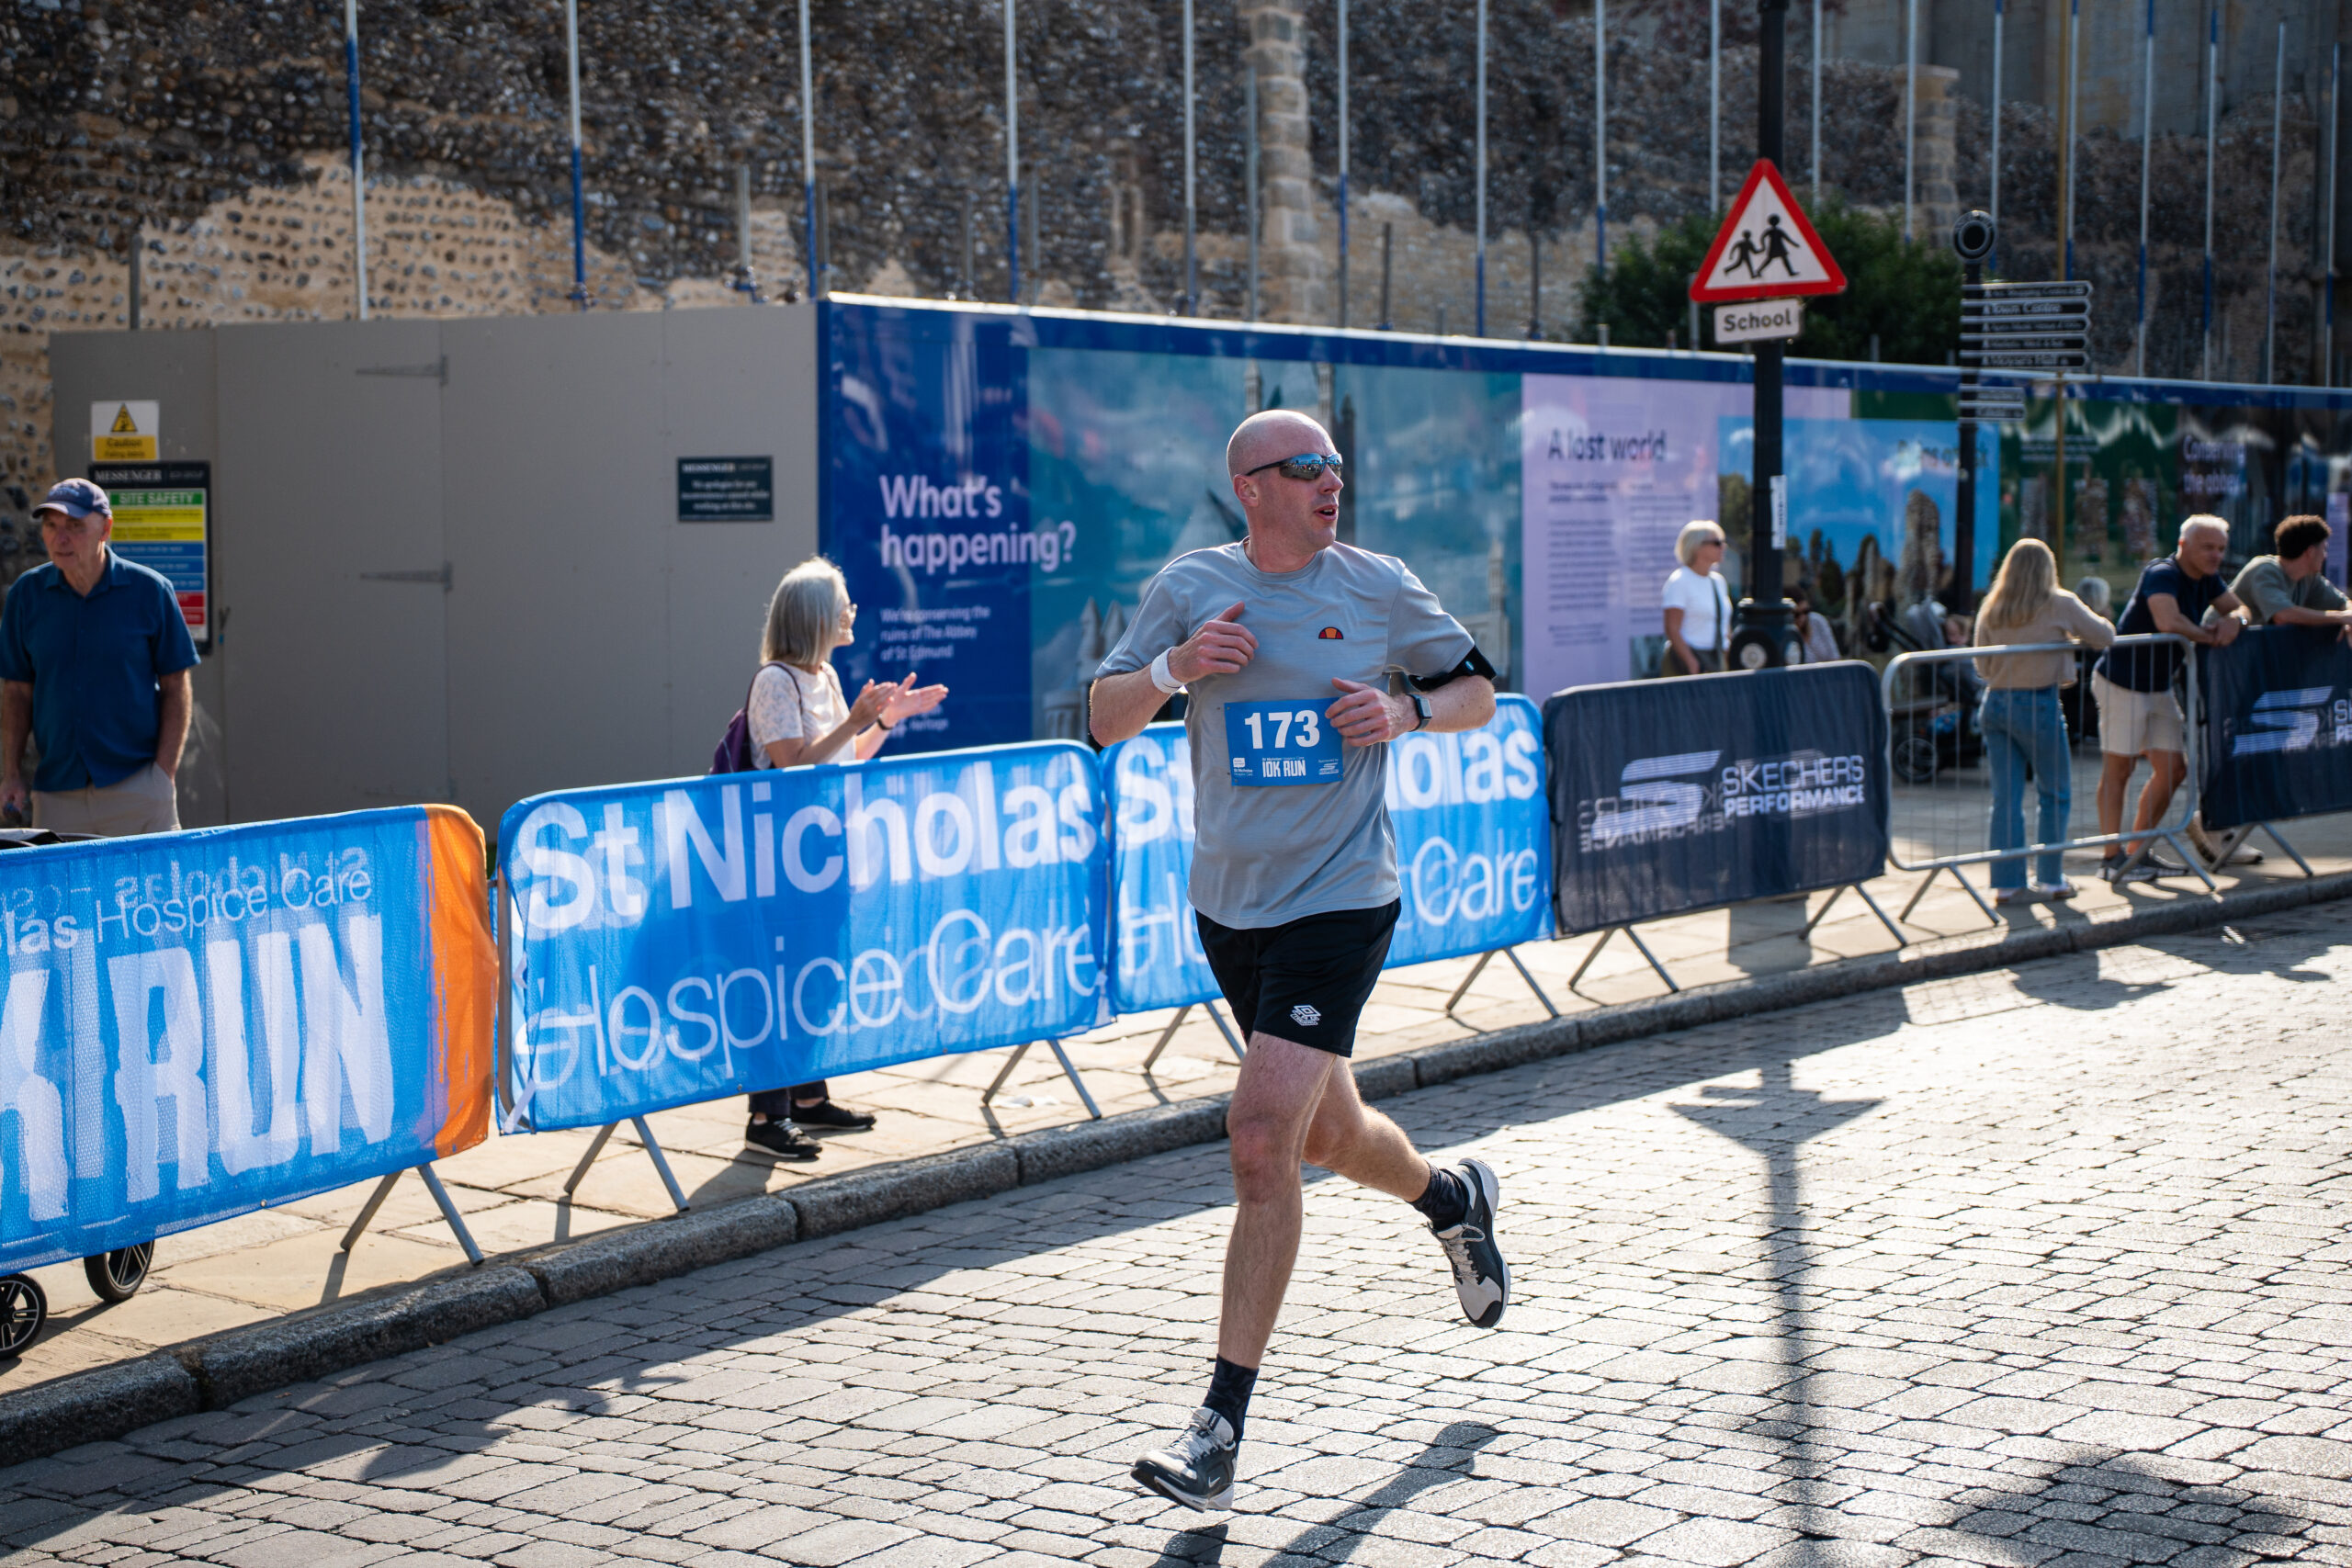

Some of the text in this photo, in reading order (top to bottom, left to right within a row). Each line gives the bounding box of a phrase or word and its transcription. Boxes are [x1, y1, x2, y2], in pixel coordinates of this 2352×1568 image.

[1723, 308, 1792, 332] School
[1991, 301, 2063, 315] Town Centre
[107, 437, 142, 447] Caution
[1548, 428, 1666, 461] A lost world
[94, 469, 163, 480] MESSENGER
[119, 492, 193, 503] SITE SAFETY
[879, 475, 1002, 518] What's
[881, 520, 1077, 575] happening?
[879, 605, 991, 624] We're conserving the
[880, 625, 978, 641] ruins of The Abbey
[880, 643, 955, 661] of St Edmund
[1244, 709, 1320, 750] 173
[1261, 760, 1282, 778] 10K
[1283, 760, 1306, 777] RUN
[1722, 755, 1865, 798] SKECHERS
[1115, 736, 1195, 844] St
[1724, 784, 1865, 818] PERFORMANCE
[517, 761, 1096, 930] St Nicholas
[1411, 835, 1538, 927] Care
[0, 909, 79, 956] las
[96, 882, 268, 944] Hospice
[280, 866, 372, 912] Care
[526, 935, 903, 1078] Hospice
[927, 908, 1096, 1014] Care
[107, 914, 395, 1203] RUN
